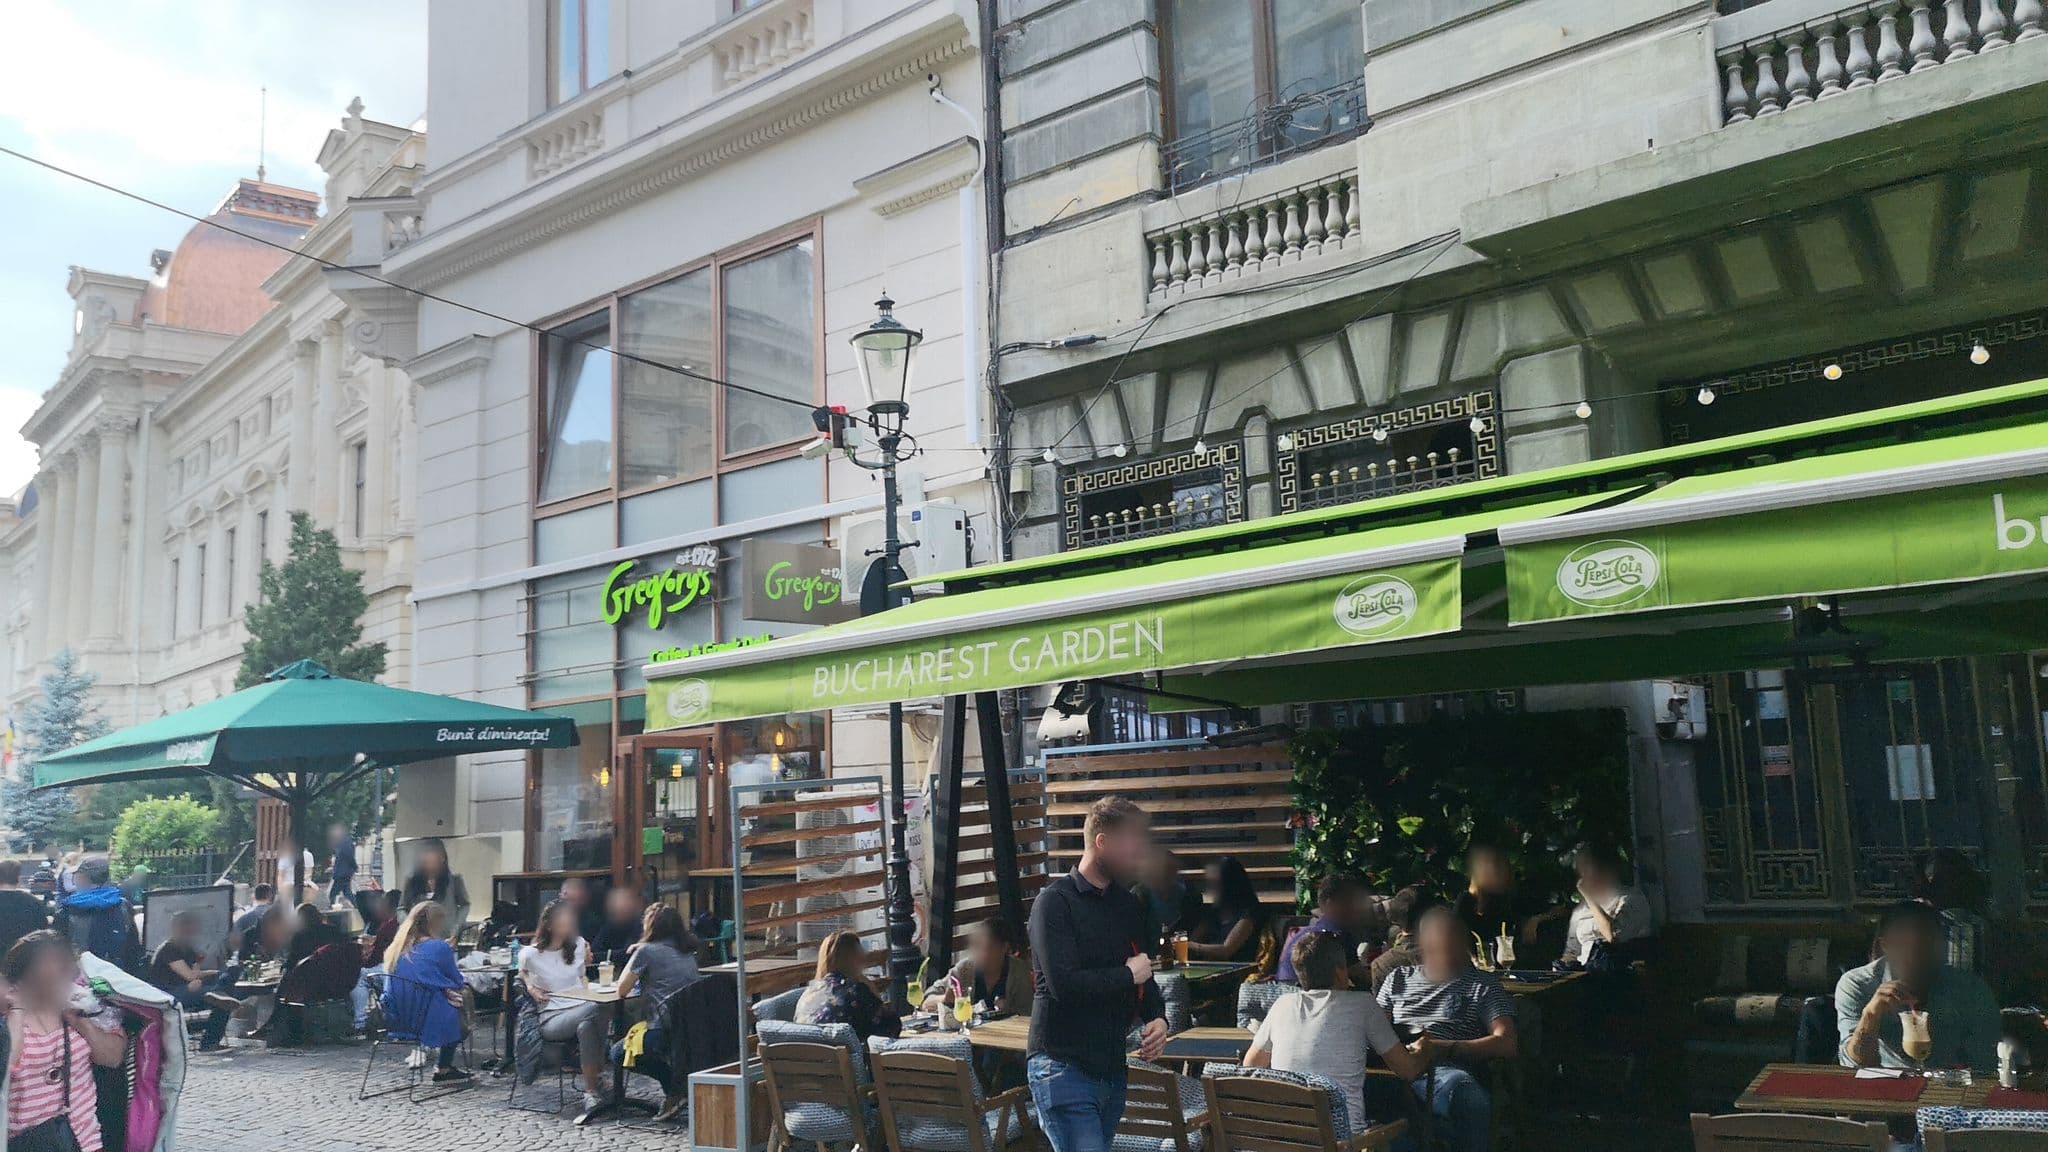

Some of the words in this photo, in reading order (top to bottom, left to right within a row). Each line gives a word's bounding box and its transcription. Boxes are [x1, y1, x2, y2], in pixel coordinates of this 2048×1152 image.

[813, 642, 998, 697] BUCHAREST
[1008, 616, 1164, 673] GARDEN
[437, 727, 475, 741] Bună
